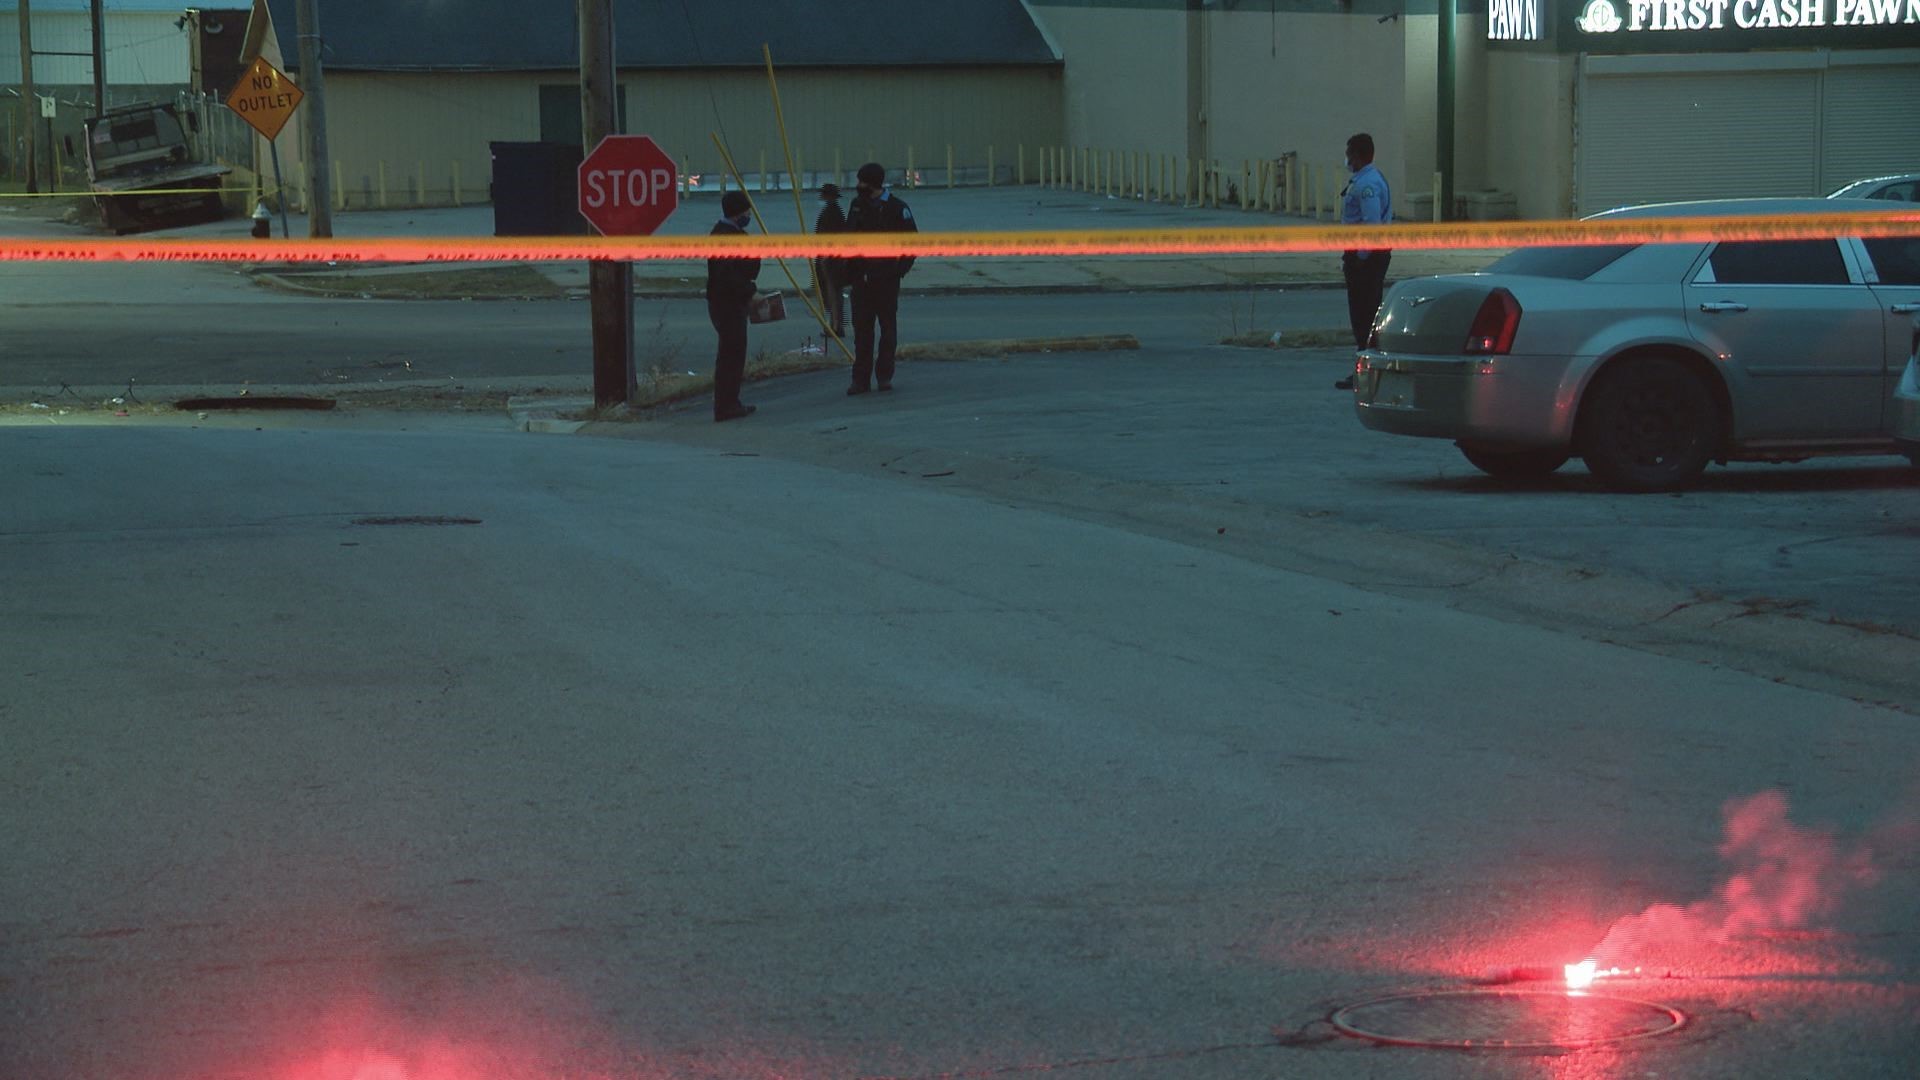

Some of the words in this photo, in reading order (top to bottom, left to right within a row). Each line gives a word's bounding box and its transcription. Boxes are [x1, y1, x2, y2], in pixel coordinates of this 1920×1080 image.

[1487, 0, 1537, 40] PAWN
[1627, 0, 1728, 31] FIRST
[1733, 0, 1826, 28] CASH
[252, 75, 272, 90] NO
[239, 93, 292, 112] OUTLET
[586, 168, 670, 208] STOP
